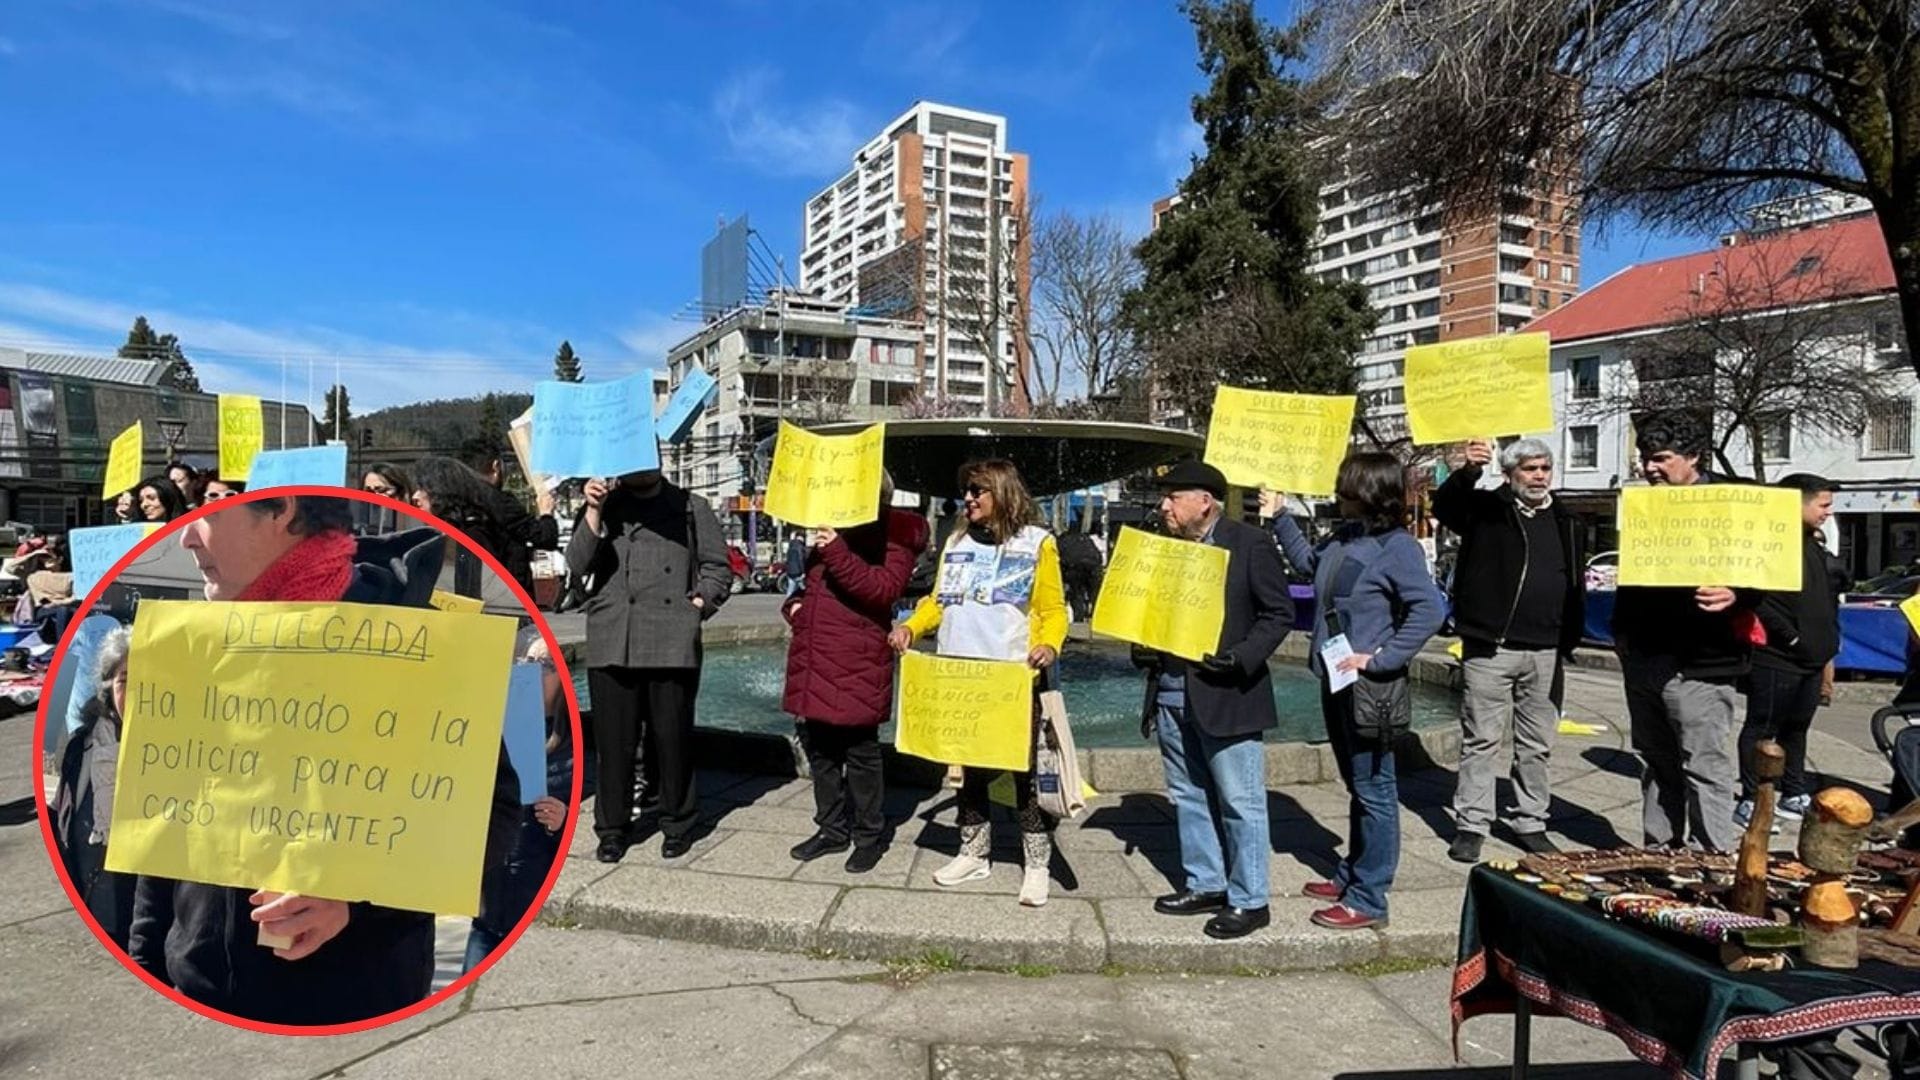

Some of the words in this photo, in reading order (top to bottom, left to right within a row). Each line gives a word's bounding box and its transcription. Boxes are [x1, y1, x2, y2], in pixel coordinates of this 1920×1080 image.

[1667, 488, 1767, 506] DELEGADA
[1627, 516, 1648, 529] Ha
[1660, 515, 1733, 532] llamado
[1744, 519, 1754, 531] a
[1768, 519, 1787, 534] la
[1708, 535, 1753, 553] para
[1762, 540, 1784, 554] un
[1633, 554, 1674, 568] caso
[1688, 555, 1766, 570] URGENTE?
[224, 611, 432, 658] DELEGADA
[138, 681, 176, 719] Ha
[203, 685, 350, 734] llamado
[375, 708, 398, 739] a
[430, 709, 471, 748] la
[292, 754, 389, 795] para
[410, 771, 456, 803] un
[142, 792, 215, 827] caso
[249, 806, 409, 855] URGENTE?
